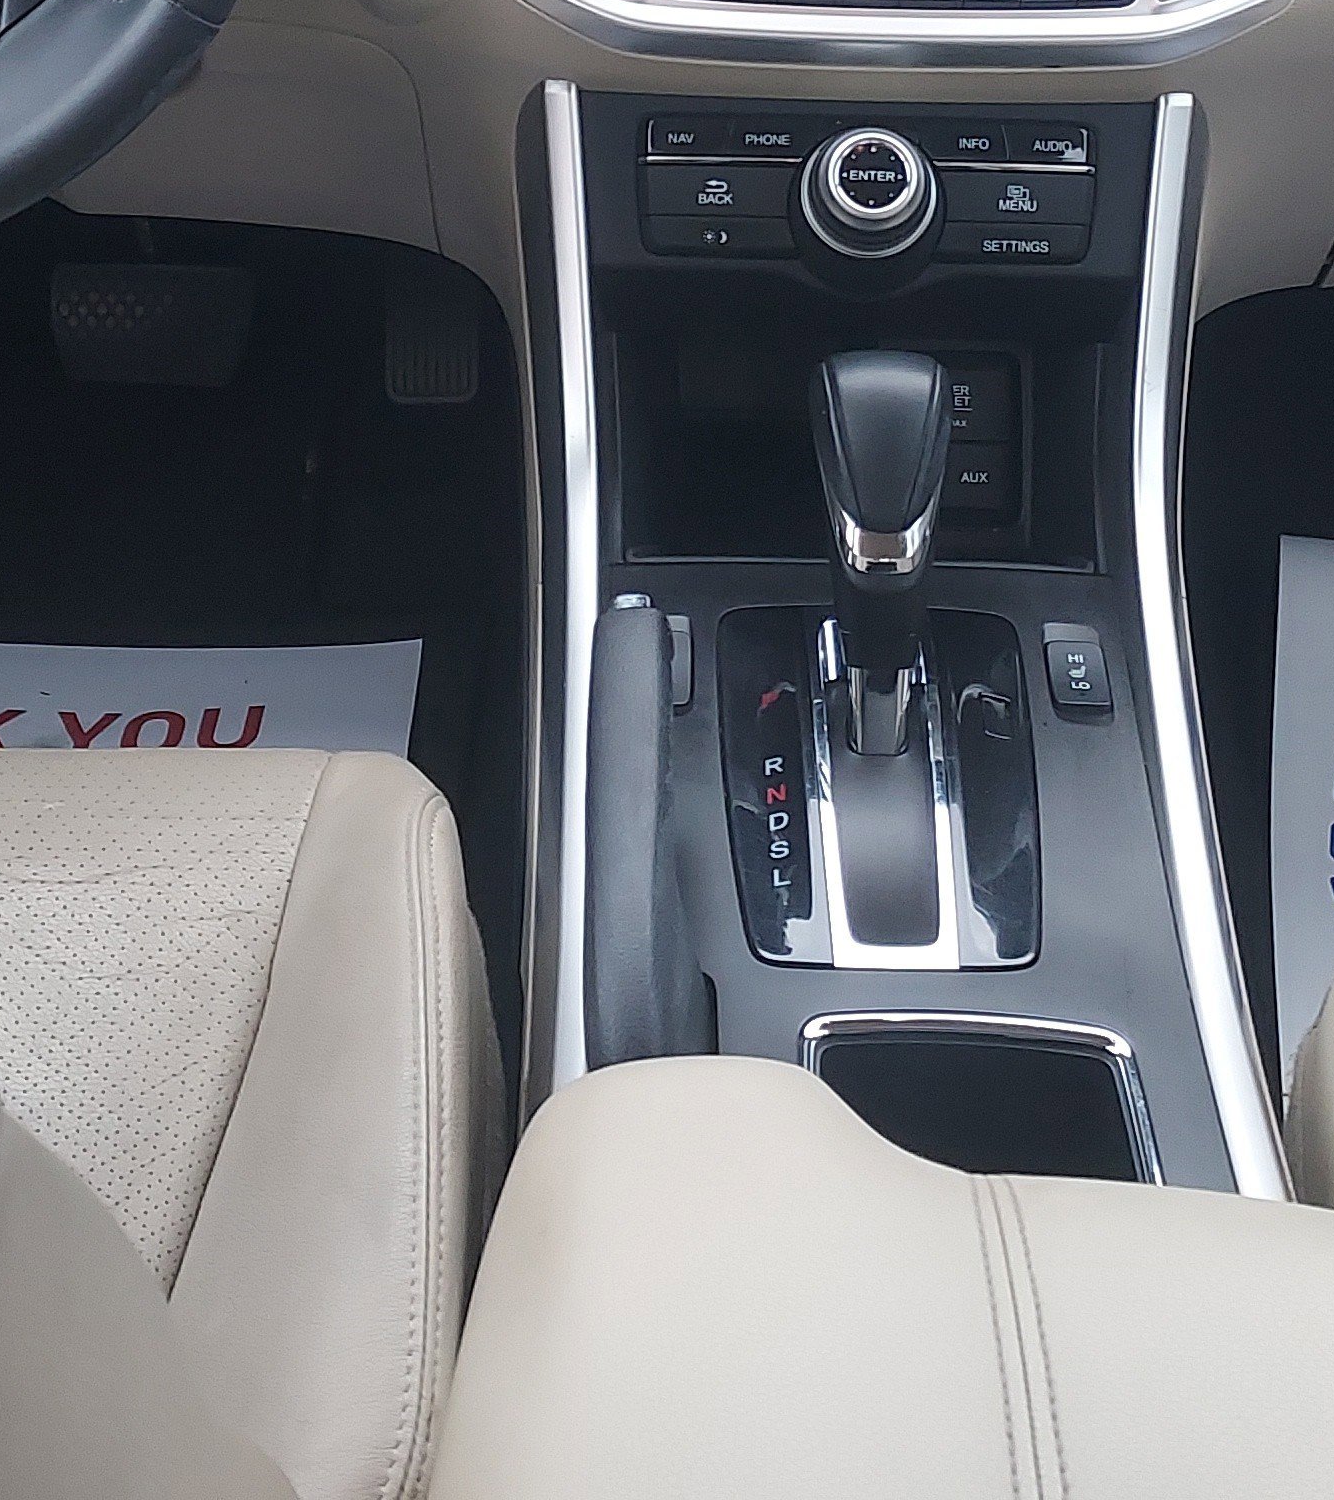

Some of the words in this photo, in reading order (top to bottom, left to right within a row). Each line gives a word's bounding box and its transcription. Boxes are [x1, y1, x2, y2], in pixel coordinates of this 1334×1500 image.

[667, 132, 694, 145] NAV
[745, 133, 791, 146] PHONE
[958, 138, 989, 151] INFO
[1033, 139, 1072, 153] AUDIO
[848, 169, 896, 183] ENTER
[698, 192, 733, 206] BACK
[998, 199, 1037, 212] MENU
[982, 240, 1049, 254] SETTINGS
[960, 472, 988, 483] AUX
[1067, 653, 1084, 664] HI
[1070, 681, 1091, 690] LO
[56, 705, 267, 750] YOU
[764, 756, 784, 776] R
[767, 783, 787, 805] N
[769, 812, 789, 831] D
[769, 840, 790, 859] S
[773, 869, 792, 887] L
